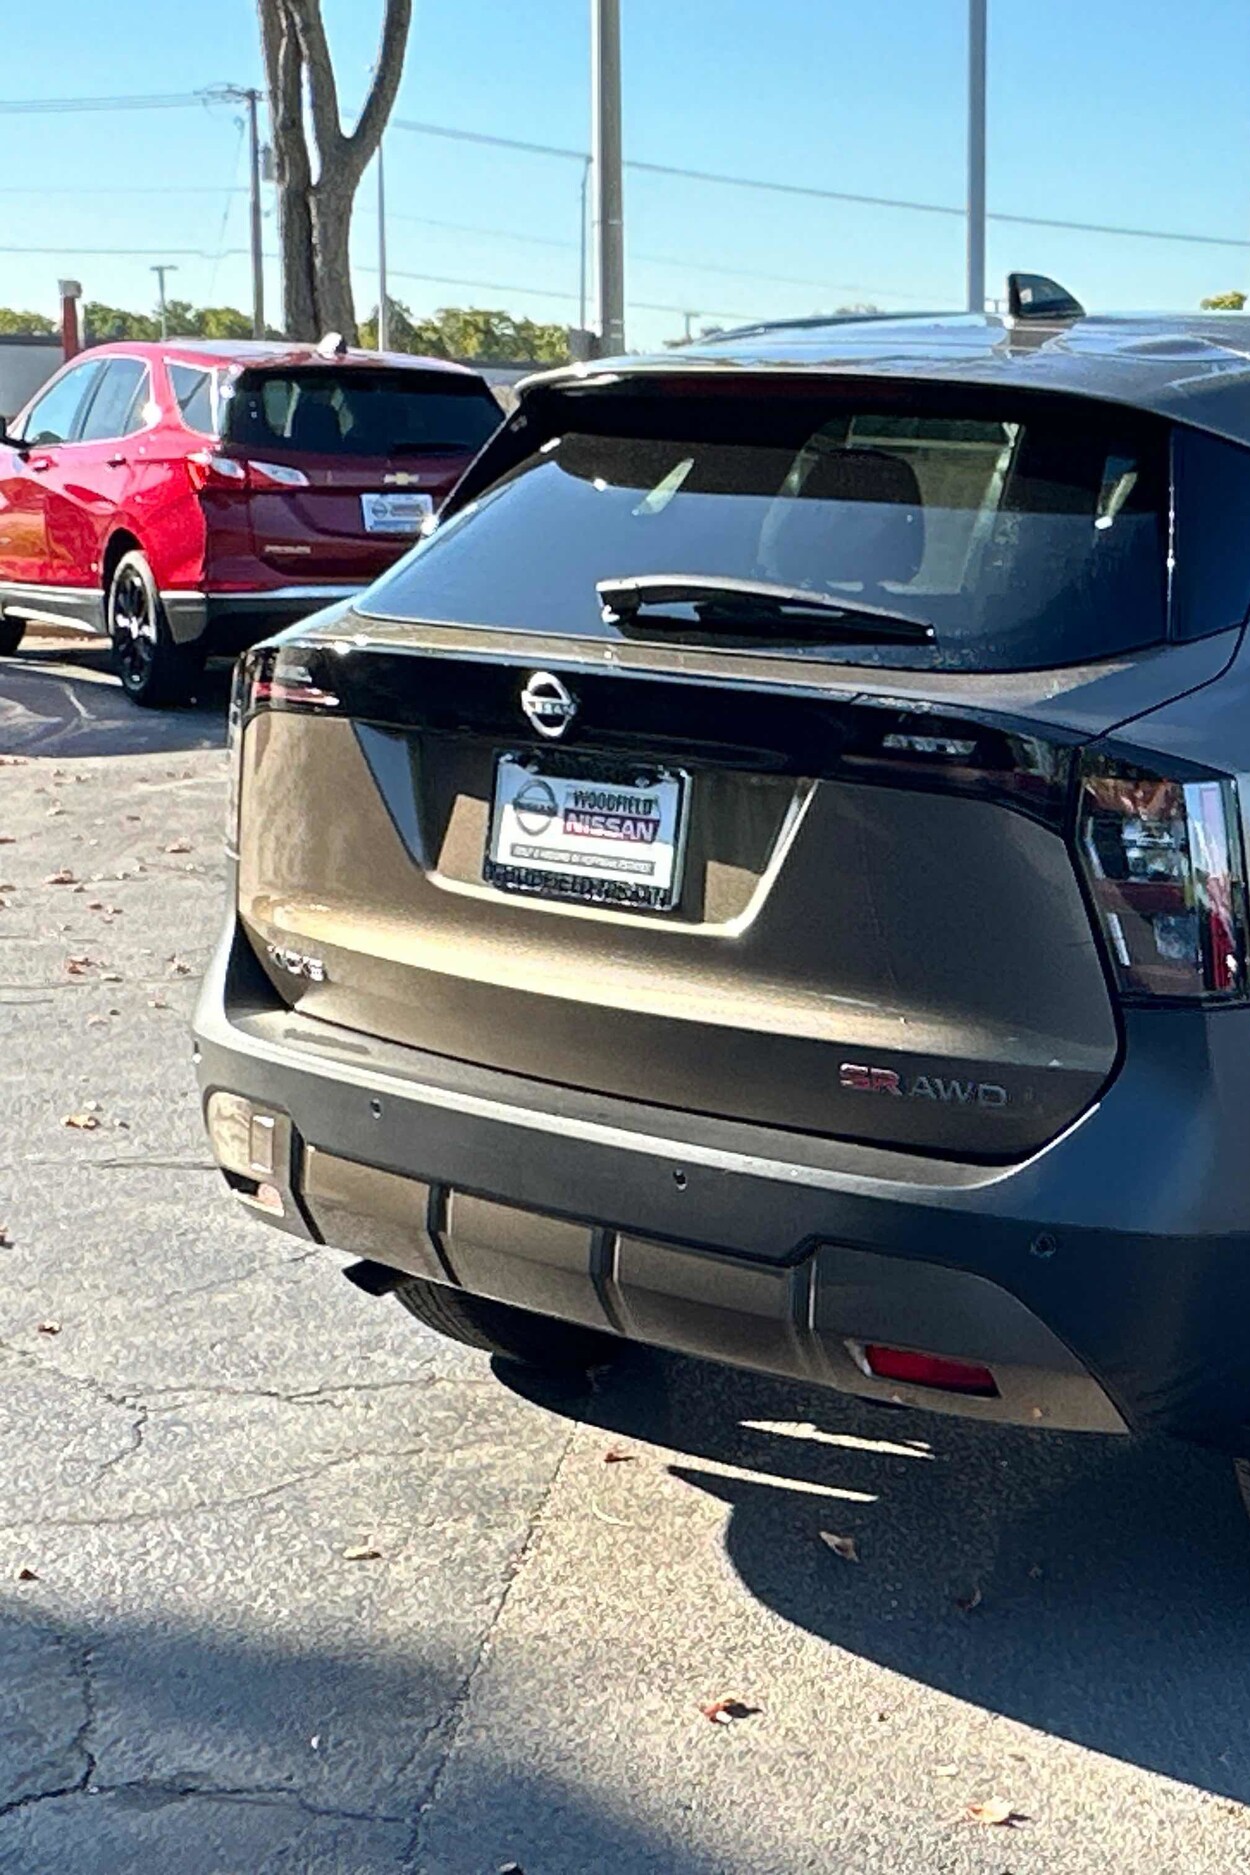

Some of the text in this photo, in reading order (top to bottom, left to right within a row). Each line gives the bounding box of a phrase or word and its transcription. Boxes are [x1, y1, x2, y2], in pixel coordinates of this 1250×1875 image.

[566, 816, 654, 841] NISSAN
[840, 1063, 1007, 1106] SR AWD
